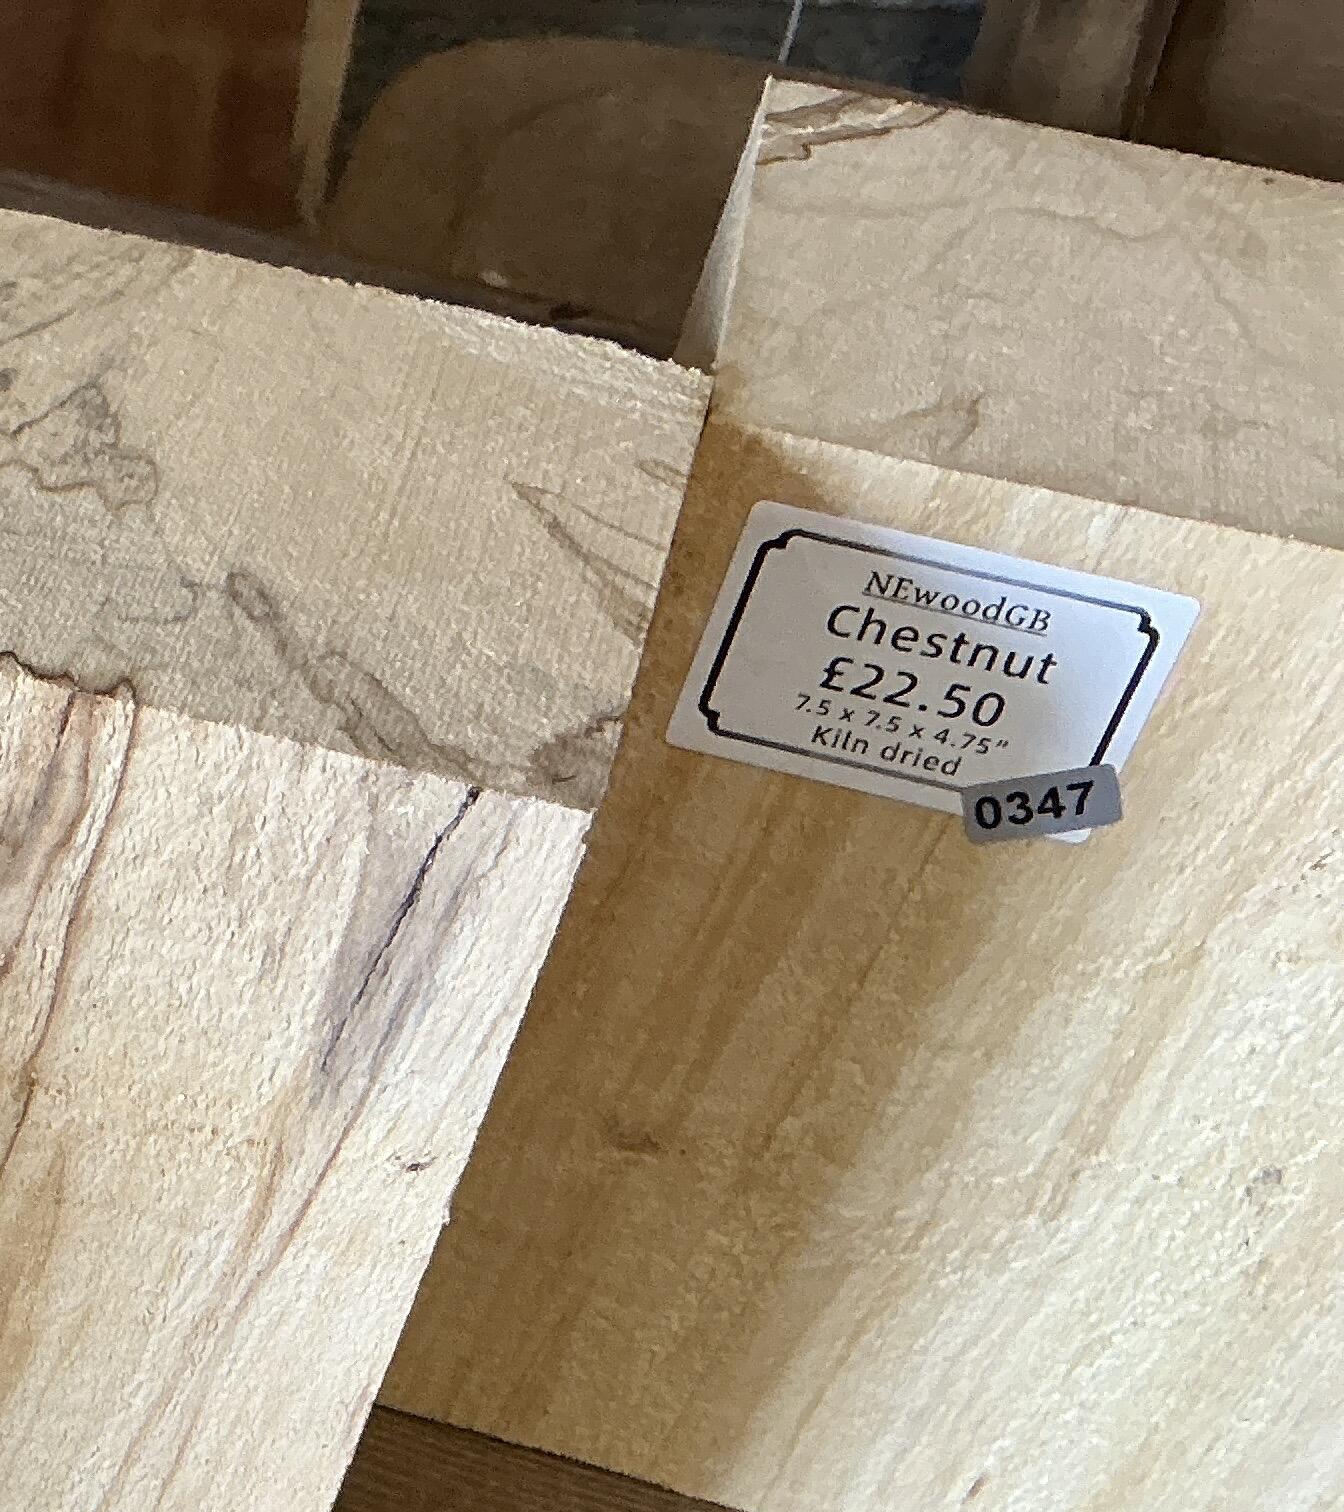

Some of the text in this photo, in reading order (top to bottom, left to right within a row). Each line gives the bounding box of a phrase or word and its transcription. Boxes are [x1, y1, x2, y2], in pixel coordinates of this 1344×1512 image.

[863, 571, 1052, 633] NEwoodGB
[826, 605, 1058, 685] Chestnut
[795, 694, 832, 716] 7.5
[865, 710, 900, 734] 7.5
[819, 656, 1006, 728] £22.50
[811, 725, 963, 777] Kiln dried
[974, 781, 1095, 830] 0347
